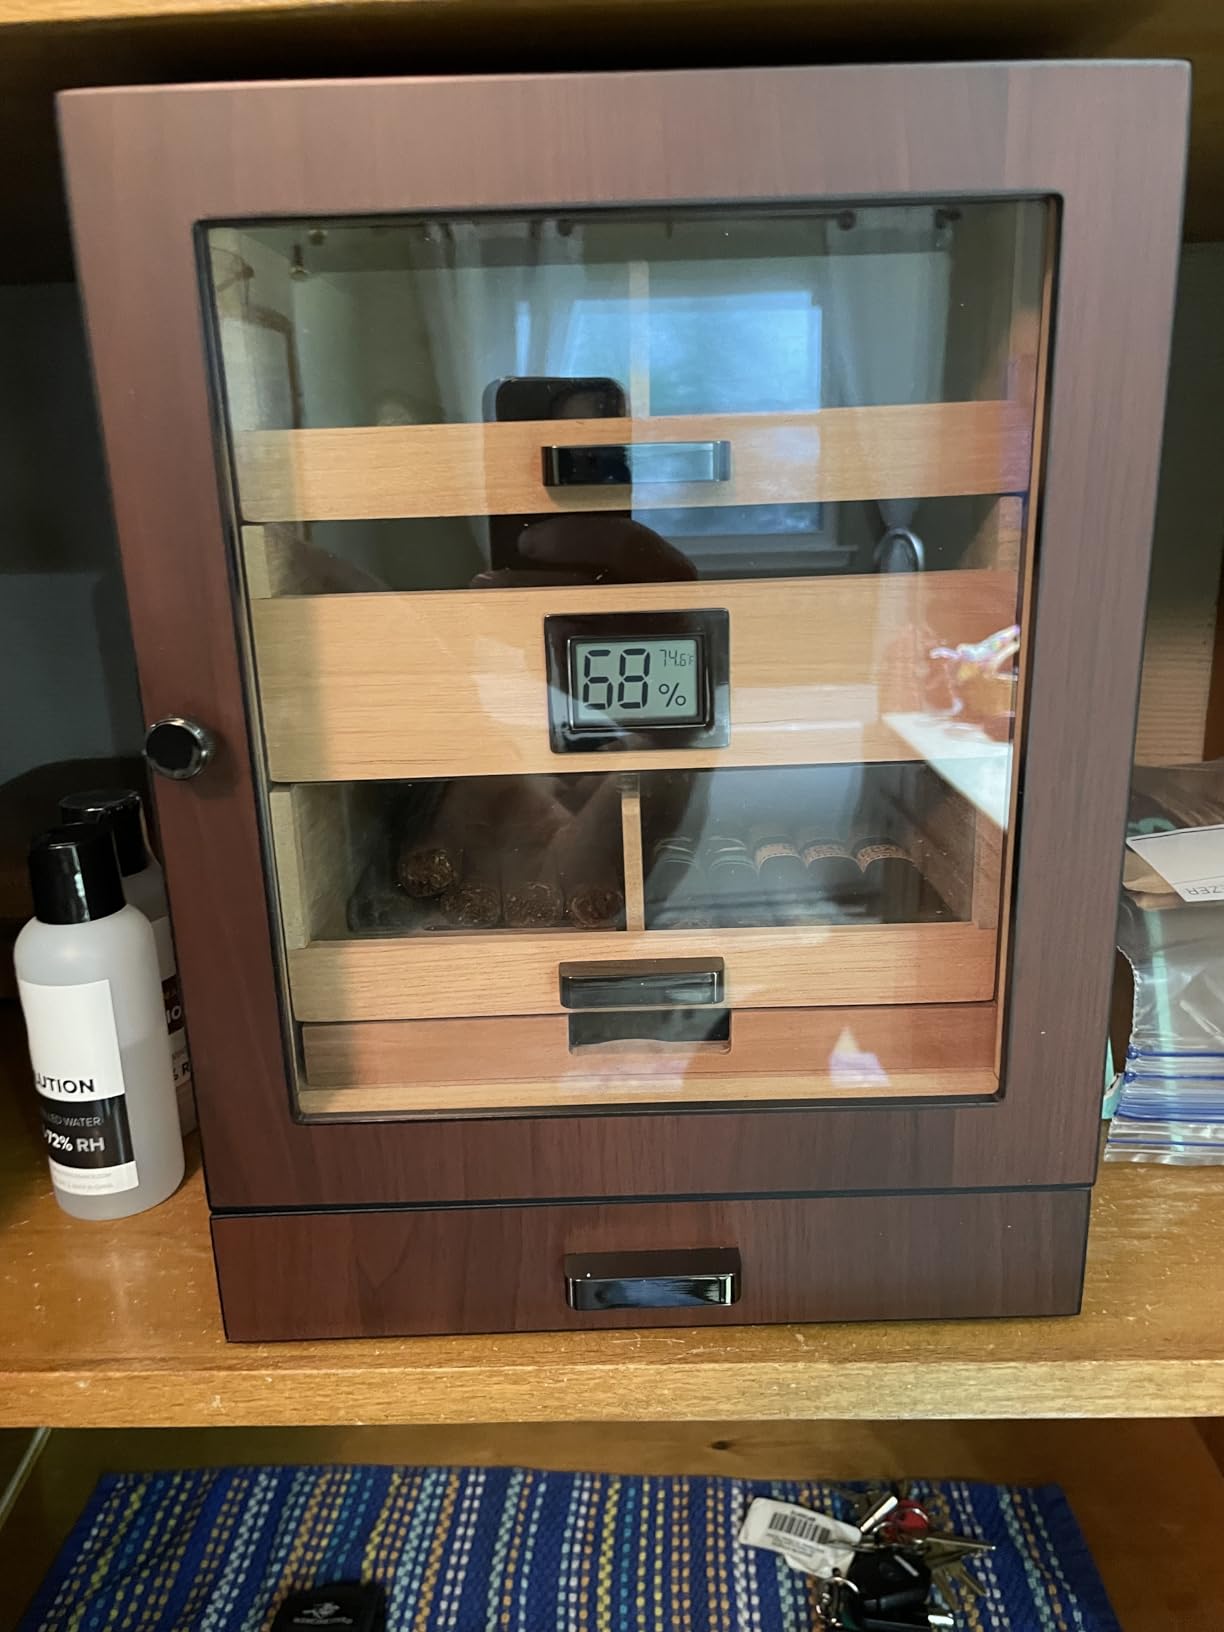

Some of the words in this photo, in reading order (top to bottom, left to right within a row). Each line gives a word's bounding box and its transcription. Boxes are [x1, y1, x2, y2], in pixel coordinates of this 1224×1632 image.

[583, 648, 651, 710] 68
[659, 682, 687, 708] %
[1184, 885, 1224, 897] ZER
[44, 1128, 74, 1152] 72%
[76, 1136, 106, 1153] RH
